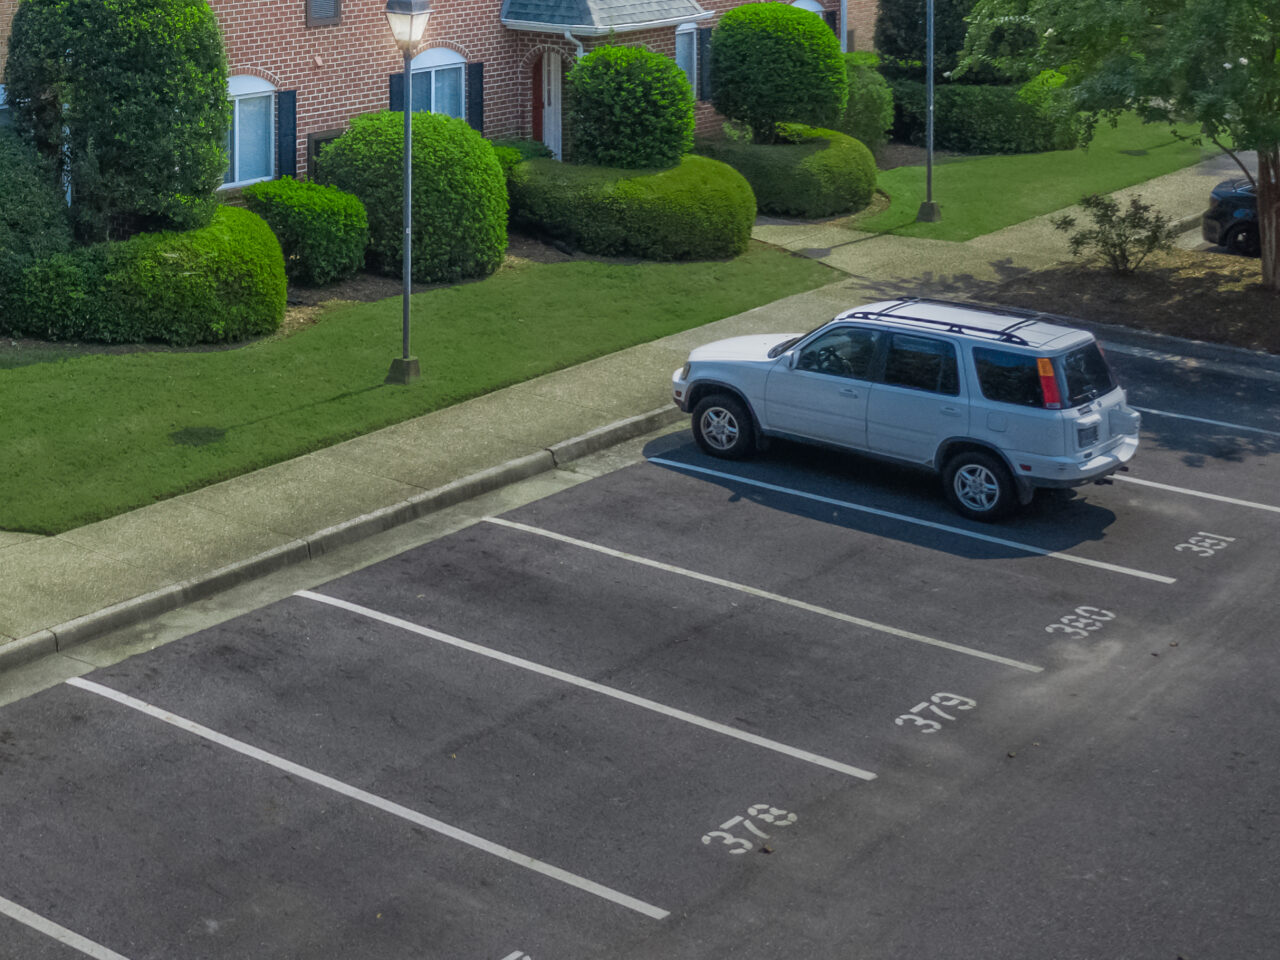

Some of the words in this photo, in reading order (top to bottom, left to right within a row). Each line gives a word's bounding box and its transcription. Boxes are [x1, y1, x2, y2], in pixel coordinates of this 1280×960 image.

[1174, 531, 1236, 557] 381
[1044, 605, 1116, 639] 380
[894, 692, 977, 733] 379
[701, 803, 797, 853] 378
